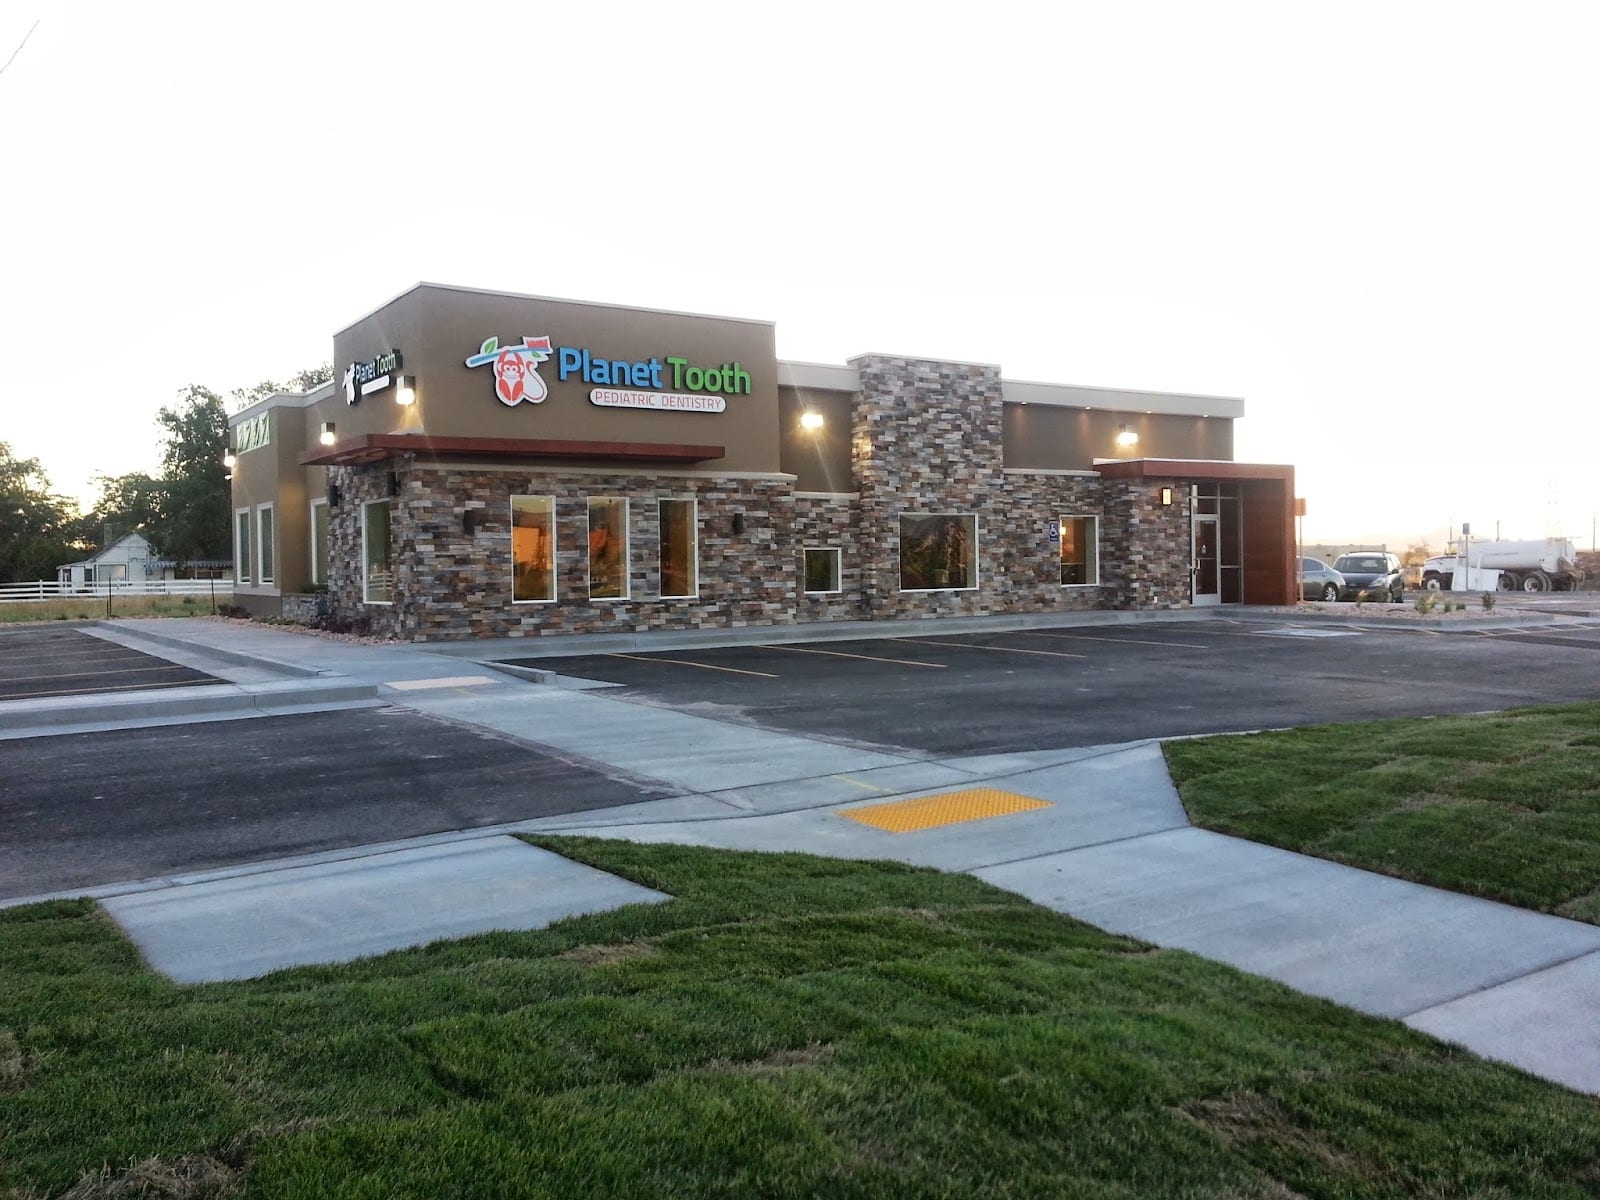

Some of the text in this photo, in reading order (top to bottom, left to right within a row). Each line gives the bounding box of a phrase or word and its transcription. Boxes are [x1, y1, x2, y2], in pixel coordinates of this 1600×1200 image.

[376, 349, 396, 375] Tooth
[558, 347, 751, 394] Planet Tooth
[595, 391, 722, 410] PEDIATRIC DENTISTRY
